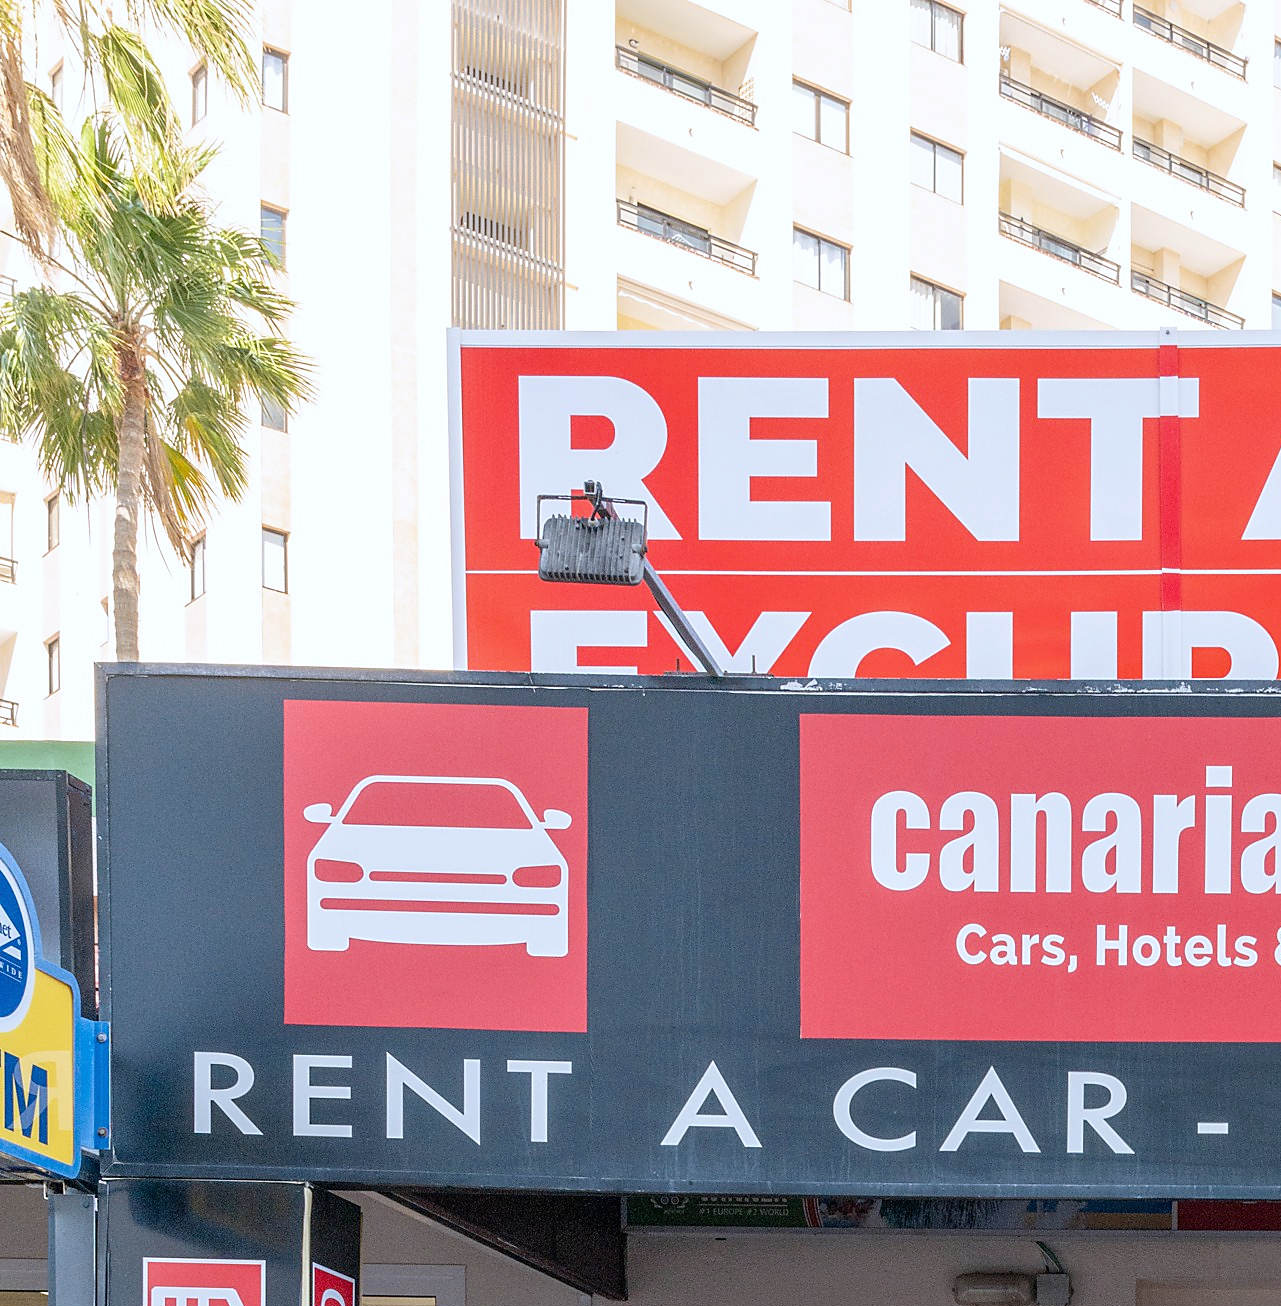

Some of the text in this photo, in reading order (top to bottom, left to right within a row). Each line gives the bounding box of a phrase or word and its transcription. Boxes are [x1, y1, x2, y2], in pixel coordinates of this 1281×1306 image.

[518, 375, 1199, 542] RENT
[955, 923, 1078, 973] Cars,
[1096, 924, 1258, 968] Hotels
[194, 1052, 572, 1146] RENT
[661, 1061, 763, 1147] A
[832, 1065, 1135, 1154] CAR
